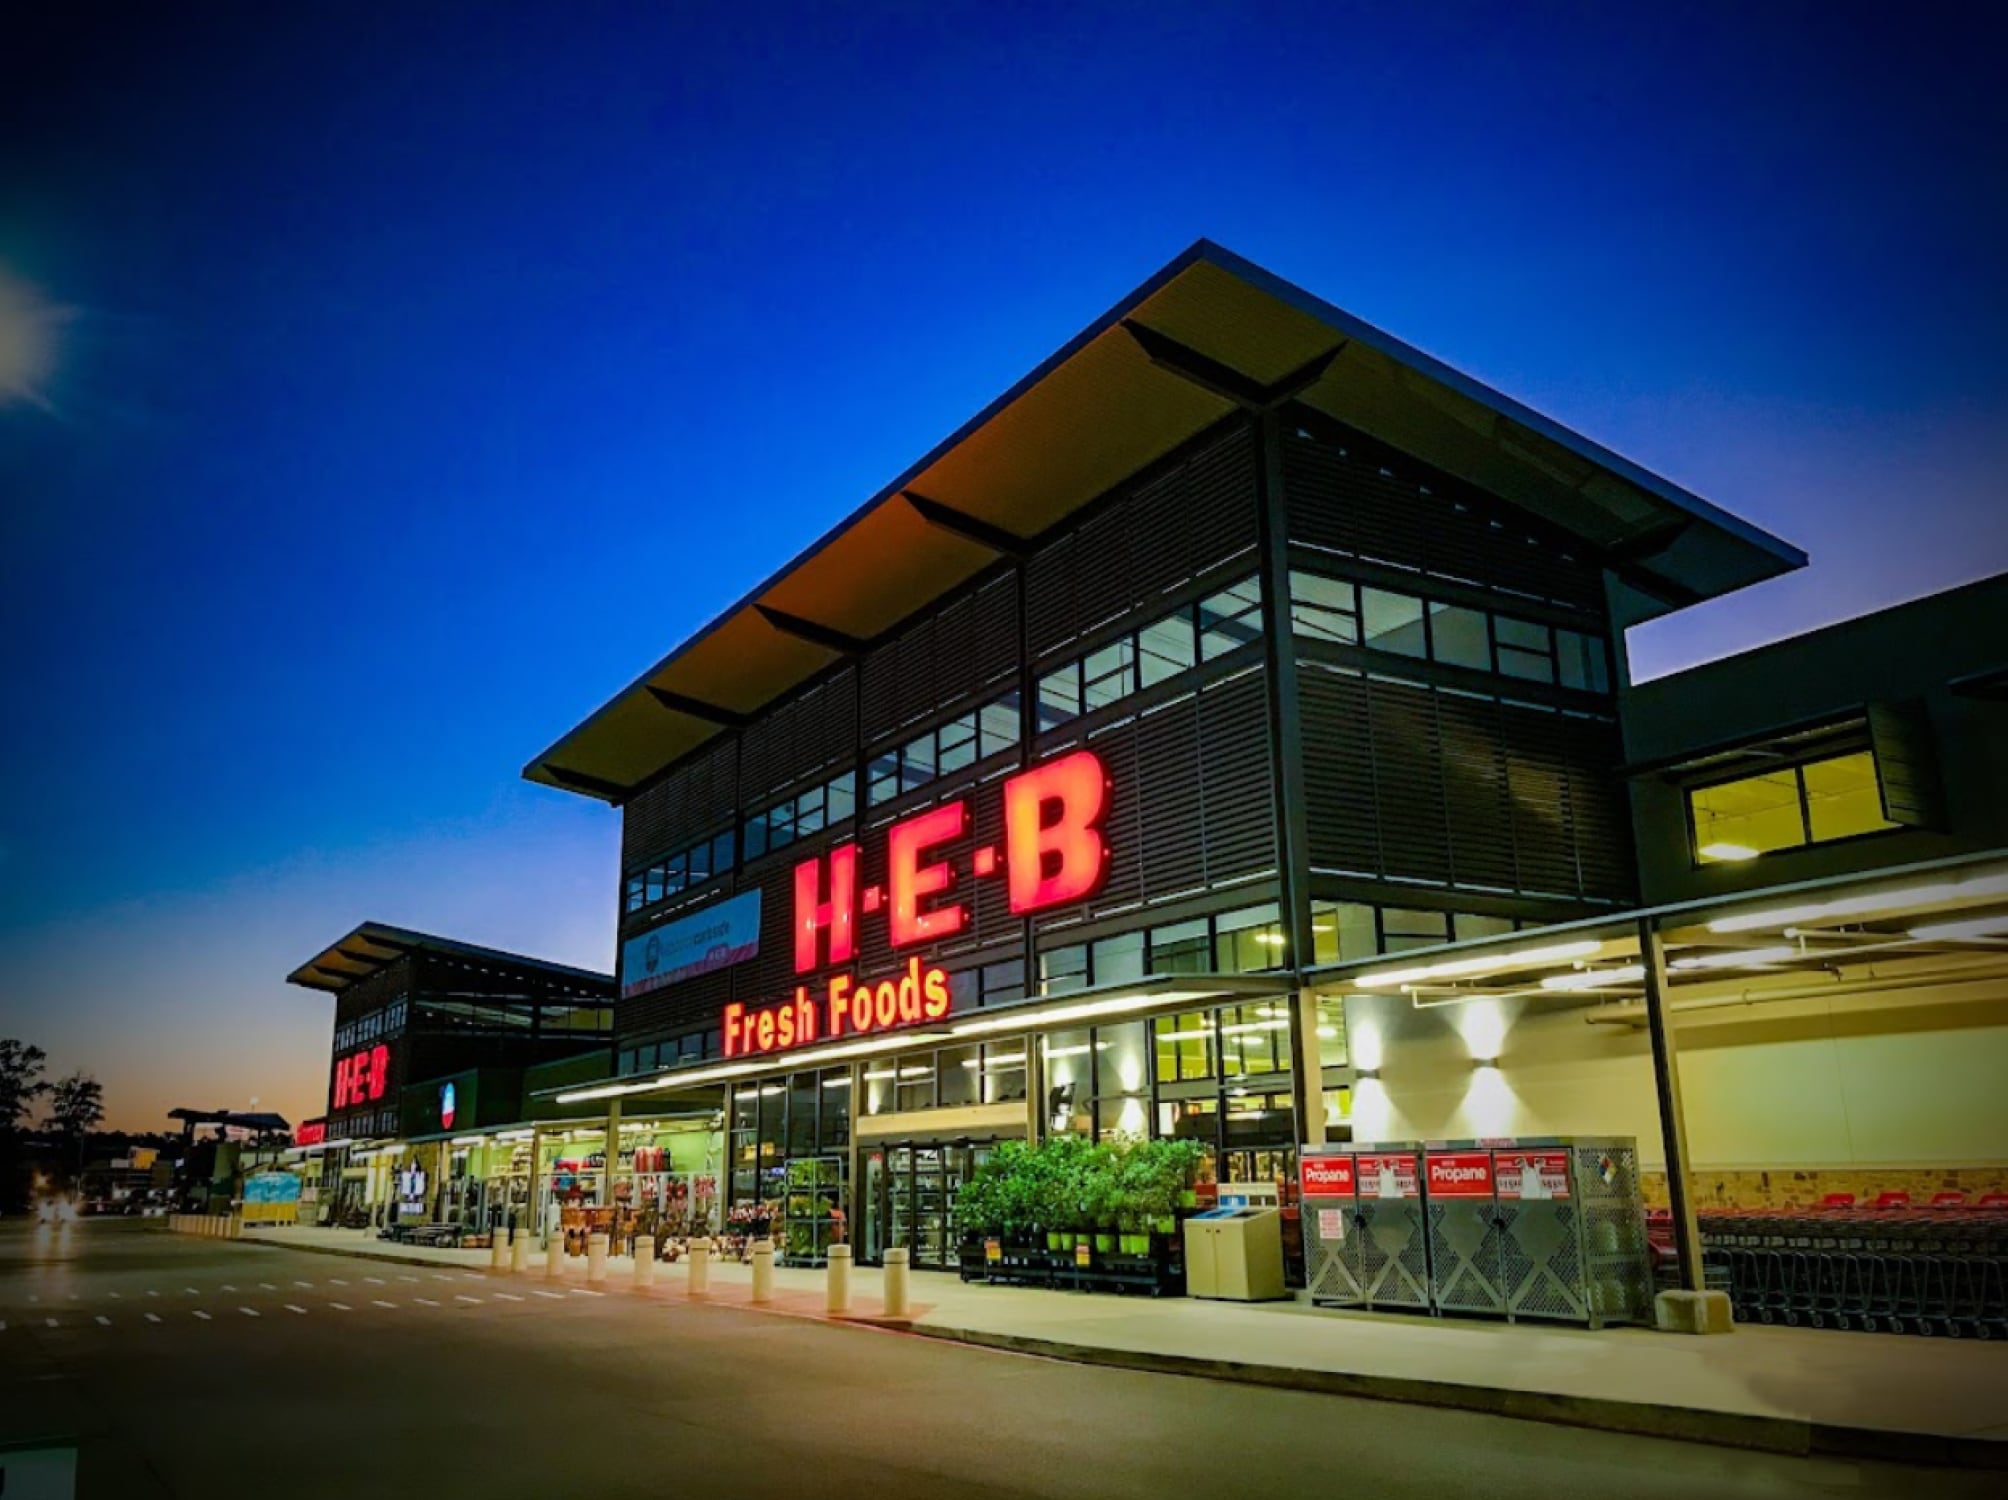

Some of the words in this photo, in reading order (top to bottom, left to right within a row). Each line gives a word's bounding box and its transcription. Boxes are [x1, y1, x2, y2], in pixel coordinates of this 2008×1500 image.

[794, 749, 1107, 974] H-E-B
[722, 985, 815, 1058] Fresh
[828, 955, 949, 1036] Foods
[333, 1043, 389, 1110] H-E-B
[1305, 1167, 1350, 1184] Propane
[1432, 1165, 1487, 1184] Propane
